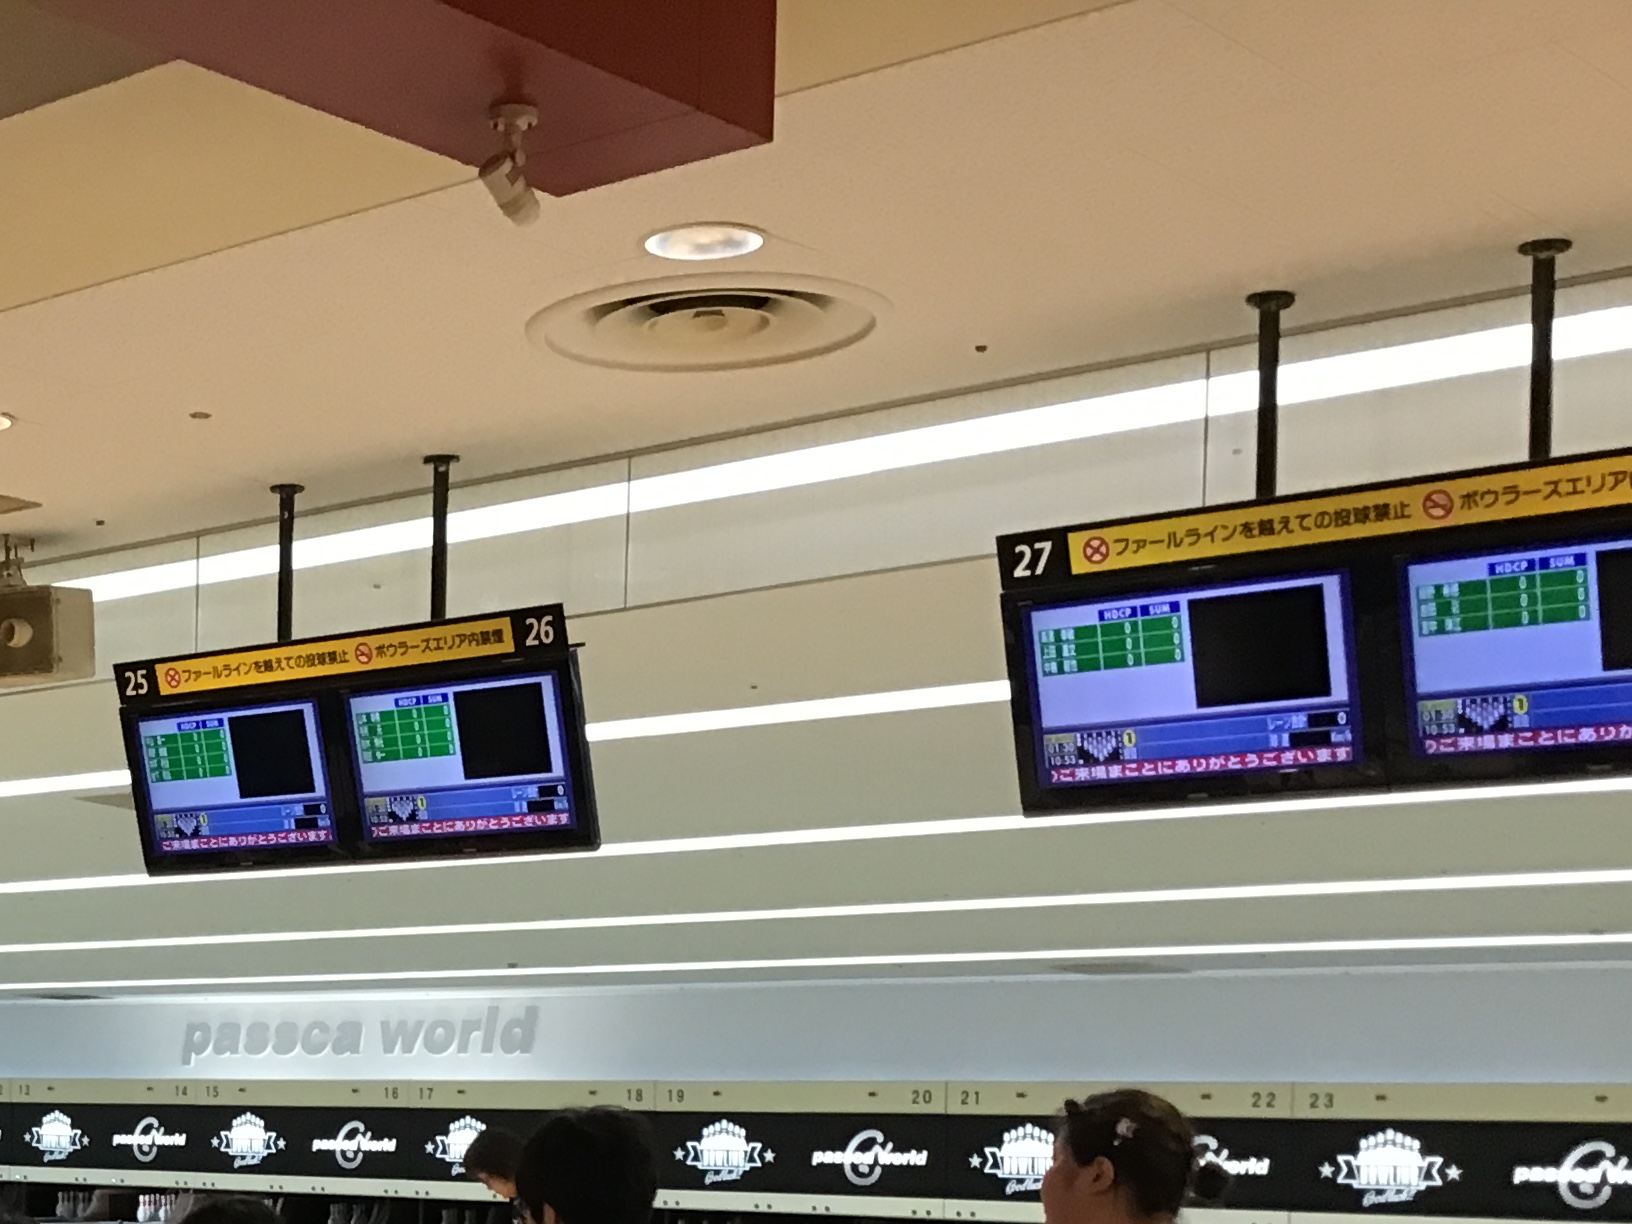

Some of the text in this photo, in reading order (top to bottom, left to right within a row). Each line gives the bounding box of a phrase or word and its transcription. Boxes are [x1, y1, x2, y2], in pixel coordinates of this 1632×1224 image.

[1013, 541, 1052, 577] 27
[1495, 556, 1575, 574] HDCP SUM
[1104, 604, 1170, 620] HDCP SUM
[525, 616, 555, 645] 26
[125, 670, 148, 696] 25
[181, 1005, 540, 1067] passca world
[175, 1086, 188, 1097] 14
[206, 1086, 219, 1098] 15
[384, 1087, 398, 1099] 16
[419, 1087, 434, 1100] 17
[627, 1089, 643, 1102] 18
[668, 1089, 685, 1103] 19
[911, 1090, 932, 1105] 20
[960, 1090, 980, 1105] 21
[1251, 1092, 1276, 1108] 22
[1309, 1093, 1334, 1109] 23
[1003, 1156, 1054, 1175] BOWLIN
